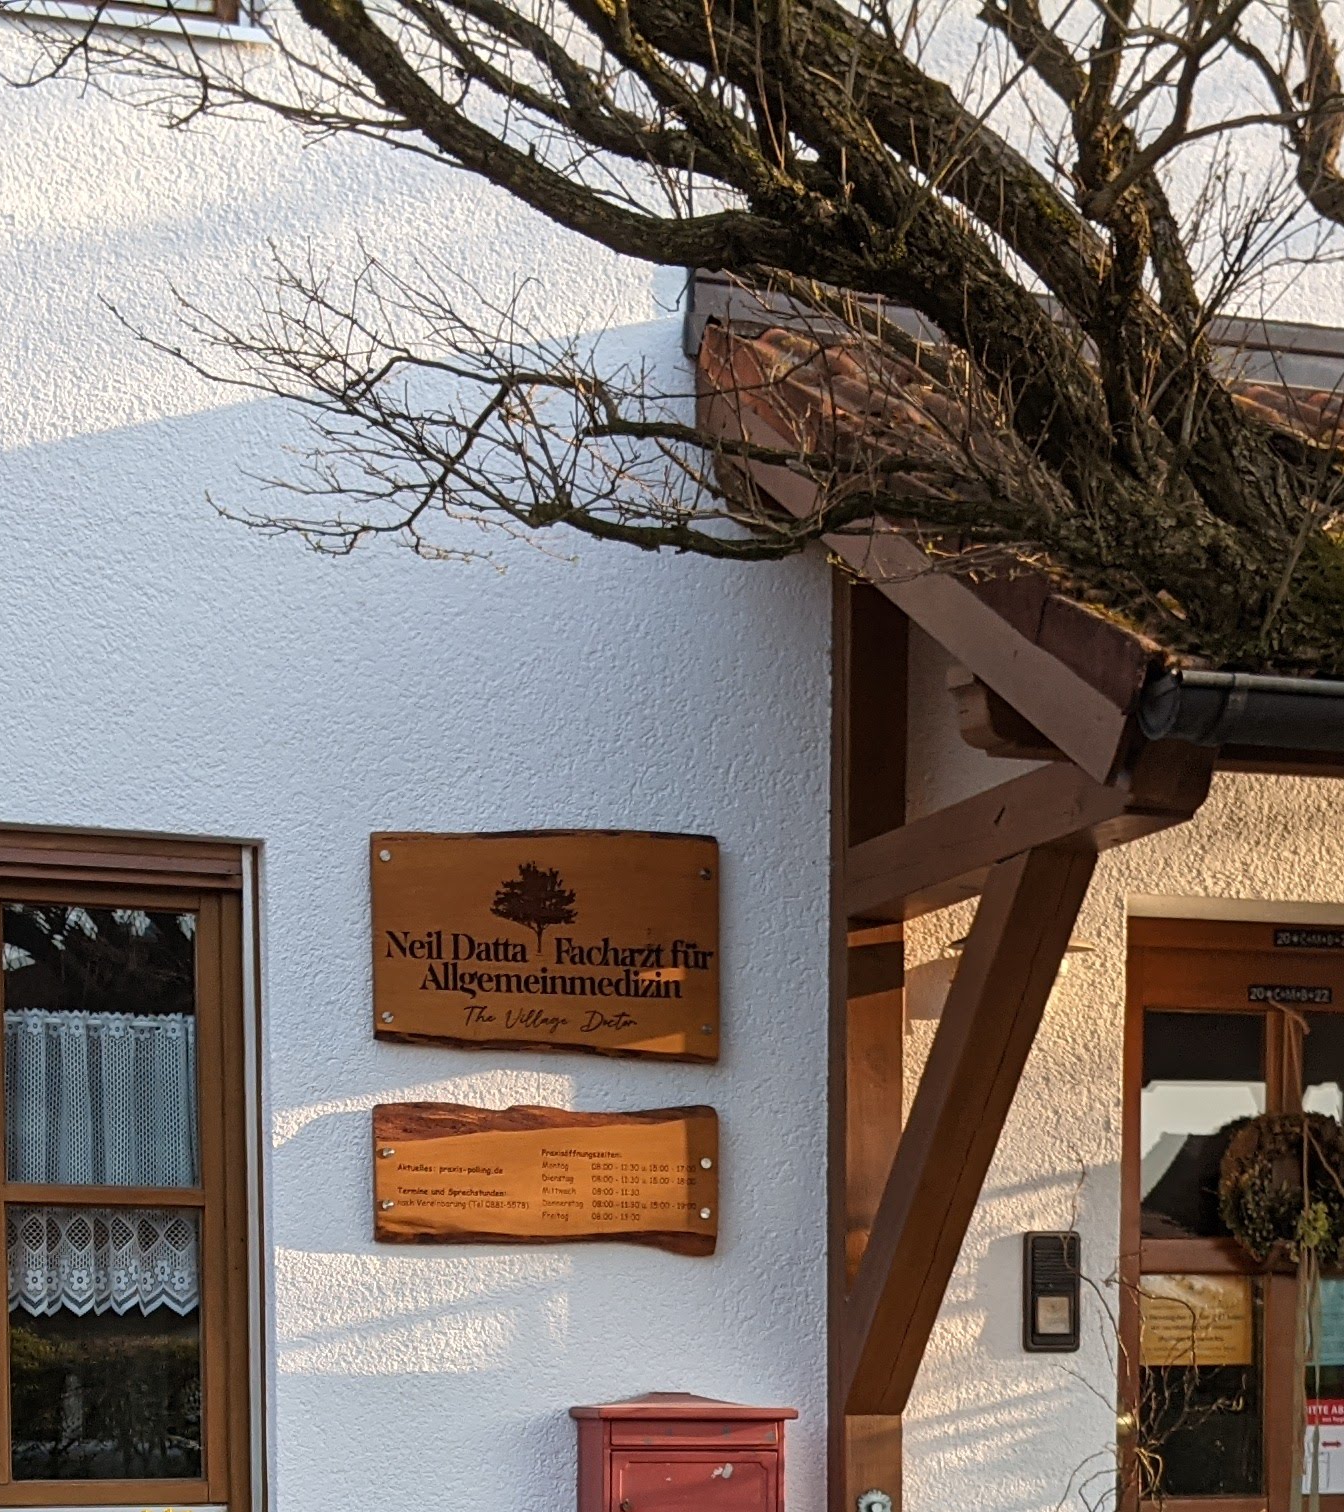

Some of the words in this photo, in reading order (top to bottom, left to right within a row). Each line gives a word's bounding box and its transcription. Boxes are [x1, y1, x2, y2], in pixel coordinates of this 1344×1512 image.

[385, 930, 443, 960] Neil
[451, 933, 529, 963] Datta
[554, 937, 664, 968] Facharzt
[671, 939, 714, 970] für
[419, 961, 683, 999] Allgemeinmedizin
[463, 1005, 496, 1026] The
[505, 1008, 568, 1033] Village
[580, 1010, 638, 1033] Doctor
[397, 1163, 436, 1172] Aktuelles:
[439, 1165, 503, 1175] praxis-polling.de
[542, 1161, 569, 1171] Montag
[397, 1186, 428, 1195] Termine
[431, 1188, 445, 1196] und
[542, 1211, 569, 1222] Freitag
[1304, 1404, 1329, 1414] ITTE
